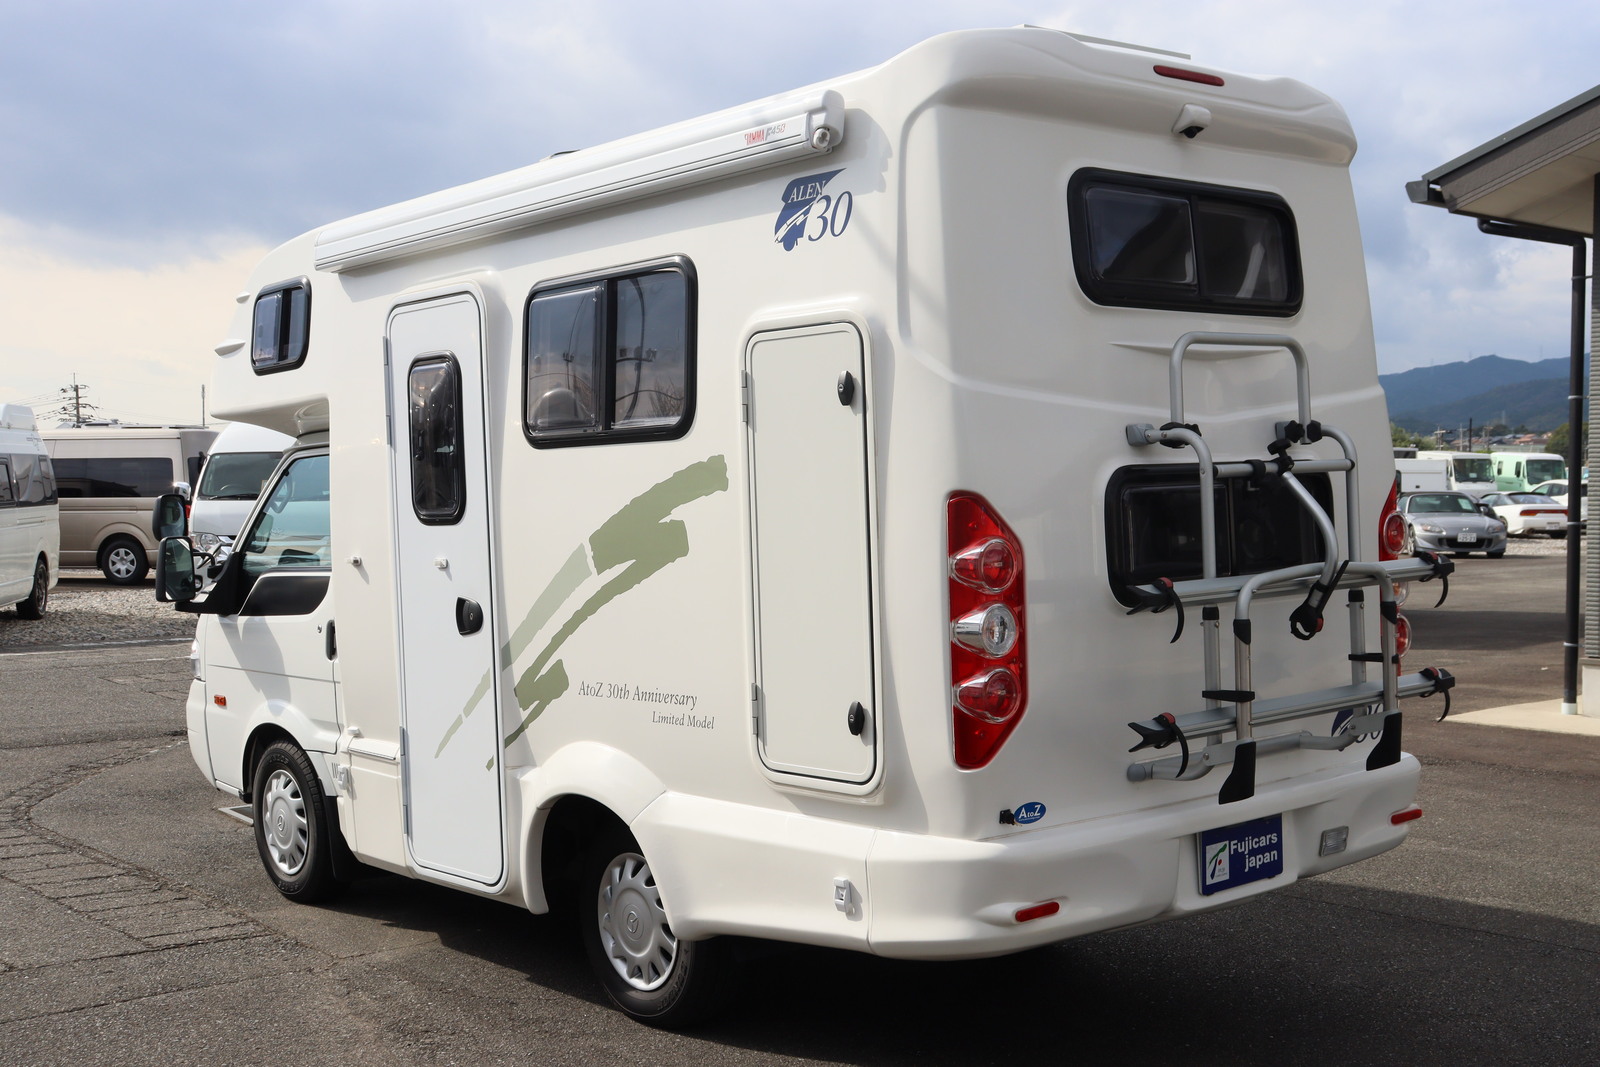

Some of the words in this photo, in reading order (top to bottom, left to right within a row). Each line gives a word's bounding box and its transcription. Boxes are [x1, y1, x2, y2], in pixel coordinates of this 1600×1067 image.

[787, 180, 827, 203] ALEN
[808, 190, 853, 241] 30
[578, 680, 604, 698] AtoZ
[606, 683, 630, 700] 30th
[632, 685, 698, 711] Anniversary
[651, 711, 685, 726] Limited
[686, 714, 715, 730] Model
[1018, 804, 1042, 819] AtoZ
[1230, 832, 1278, 855] Fujicars
[1244, 849, 1278, 873] japan
